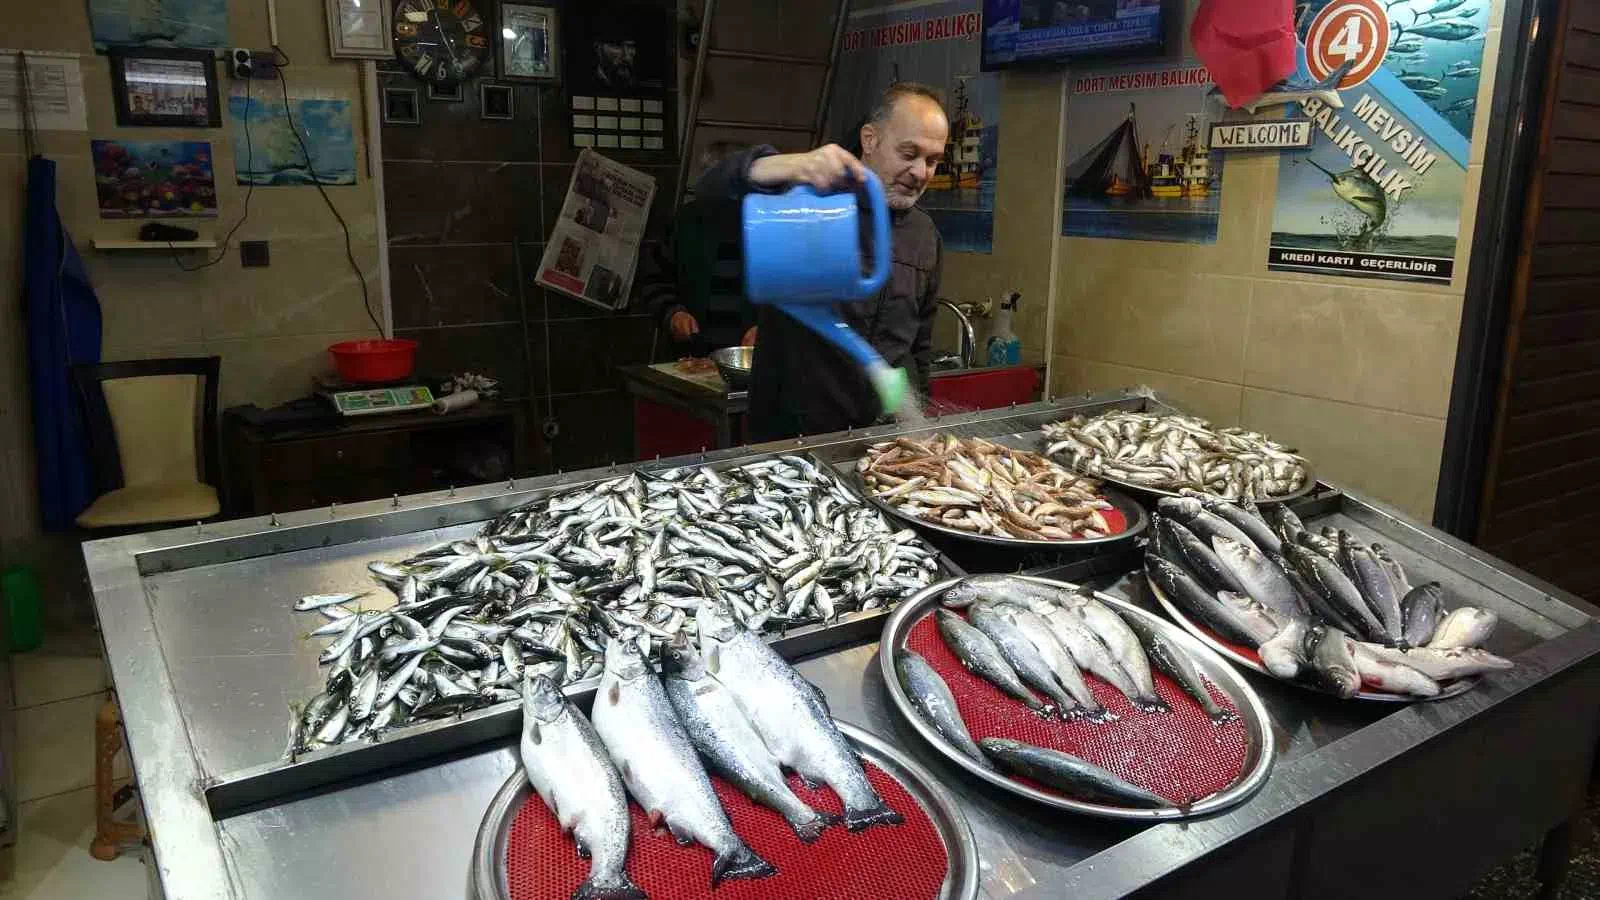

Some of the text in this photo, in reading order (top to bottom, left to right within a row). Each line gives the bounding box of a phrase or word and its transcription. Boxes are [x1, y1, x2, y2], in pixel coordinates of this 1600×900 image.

[1328, 16, 1364, 61] 4
[1219, 124, 1301, 145] WELCOME
[1303, 97, 1411, 201] BALIKÇILIK
[1352, 94, 1438, 175] MEVSİM
[1281, 252, 1437, 272] KREDİ KARTI GEÇERLİDİR
